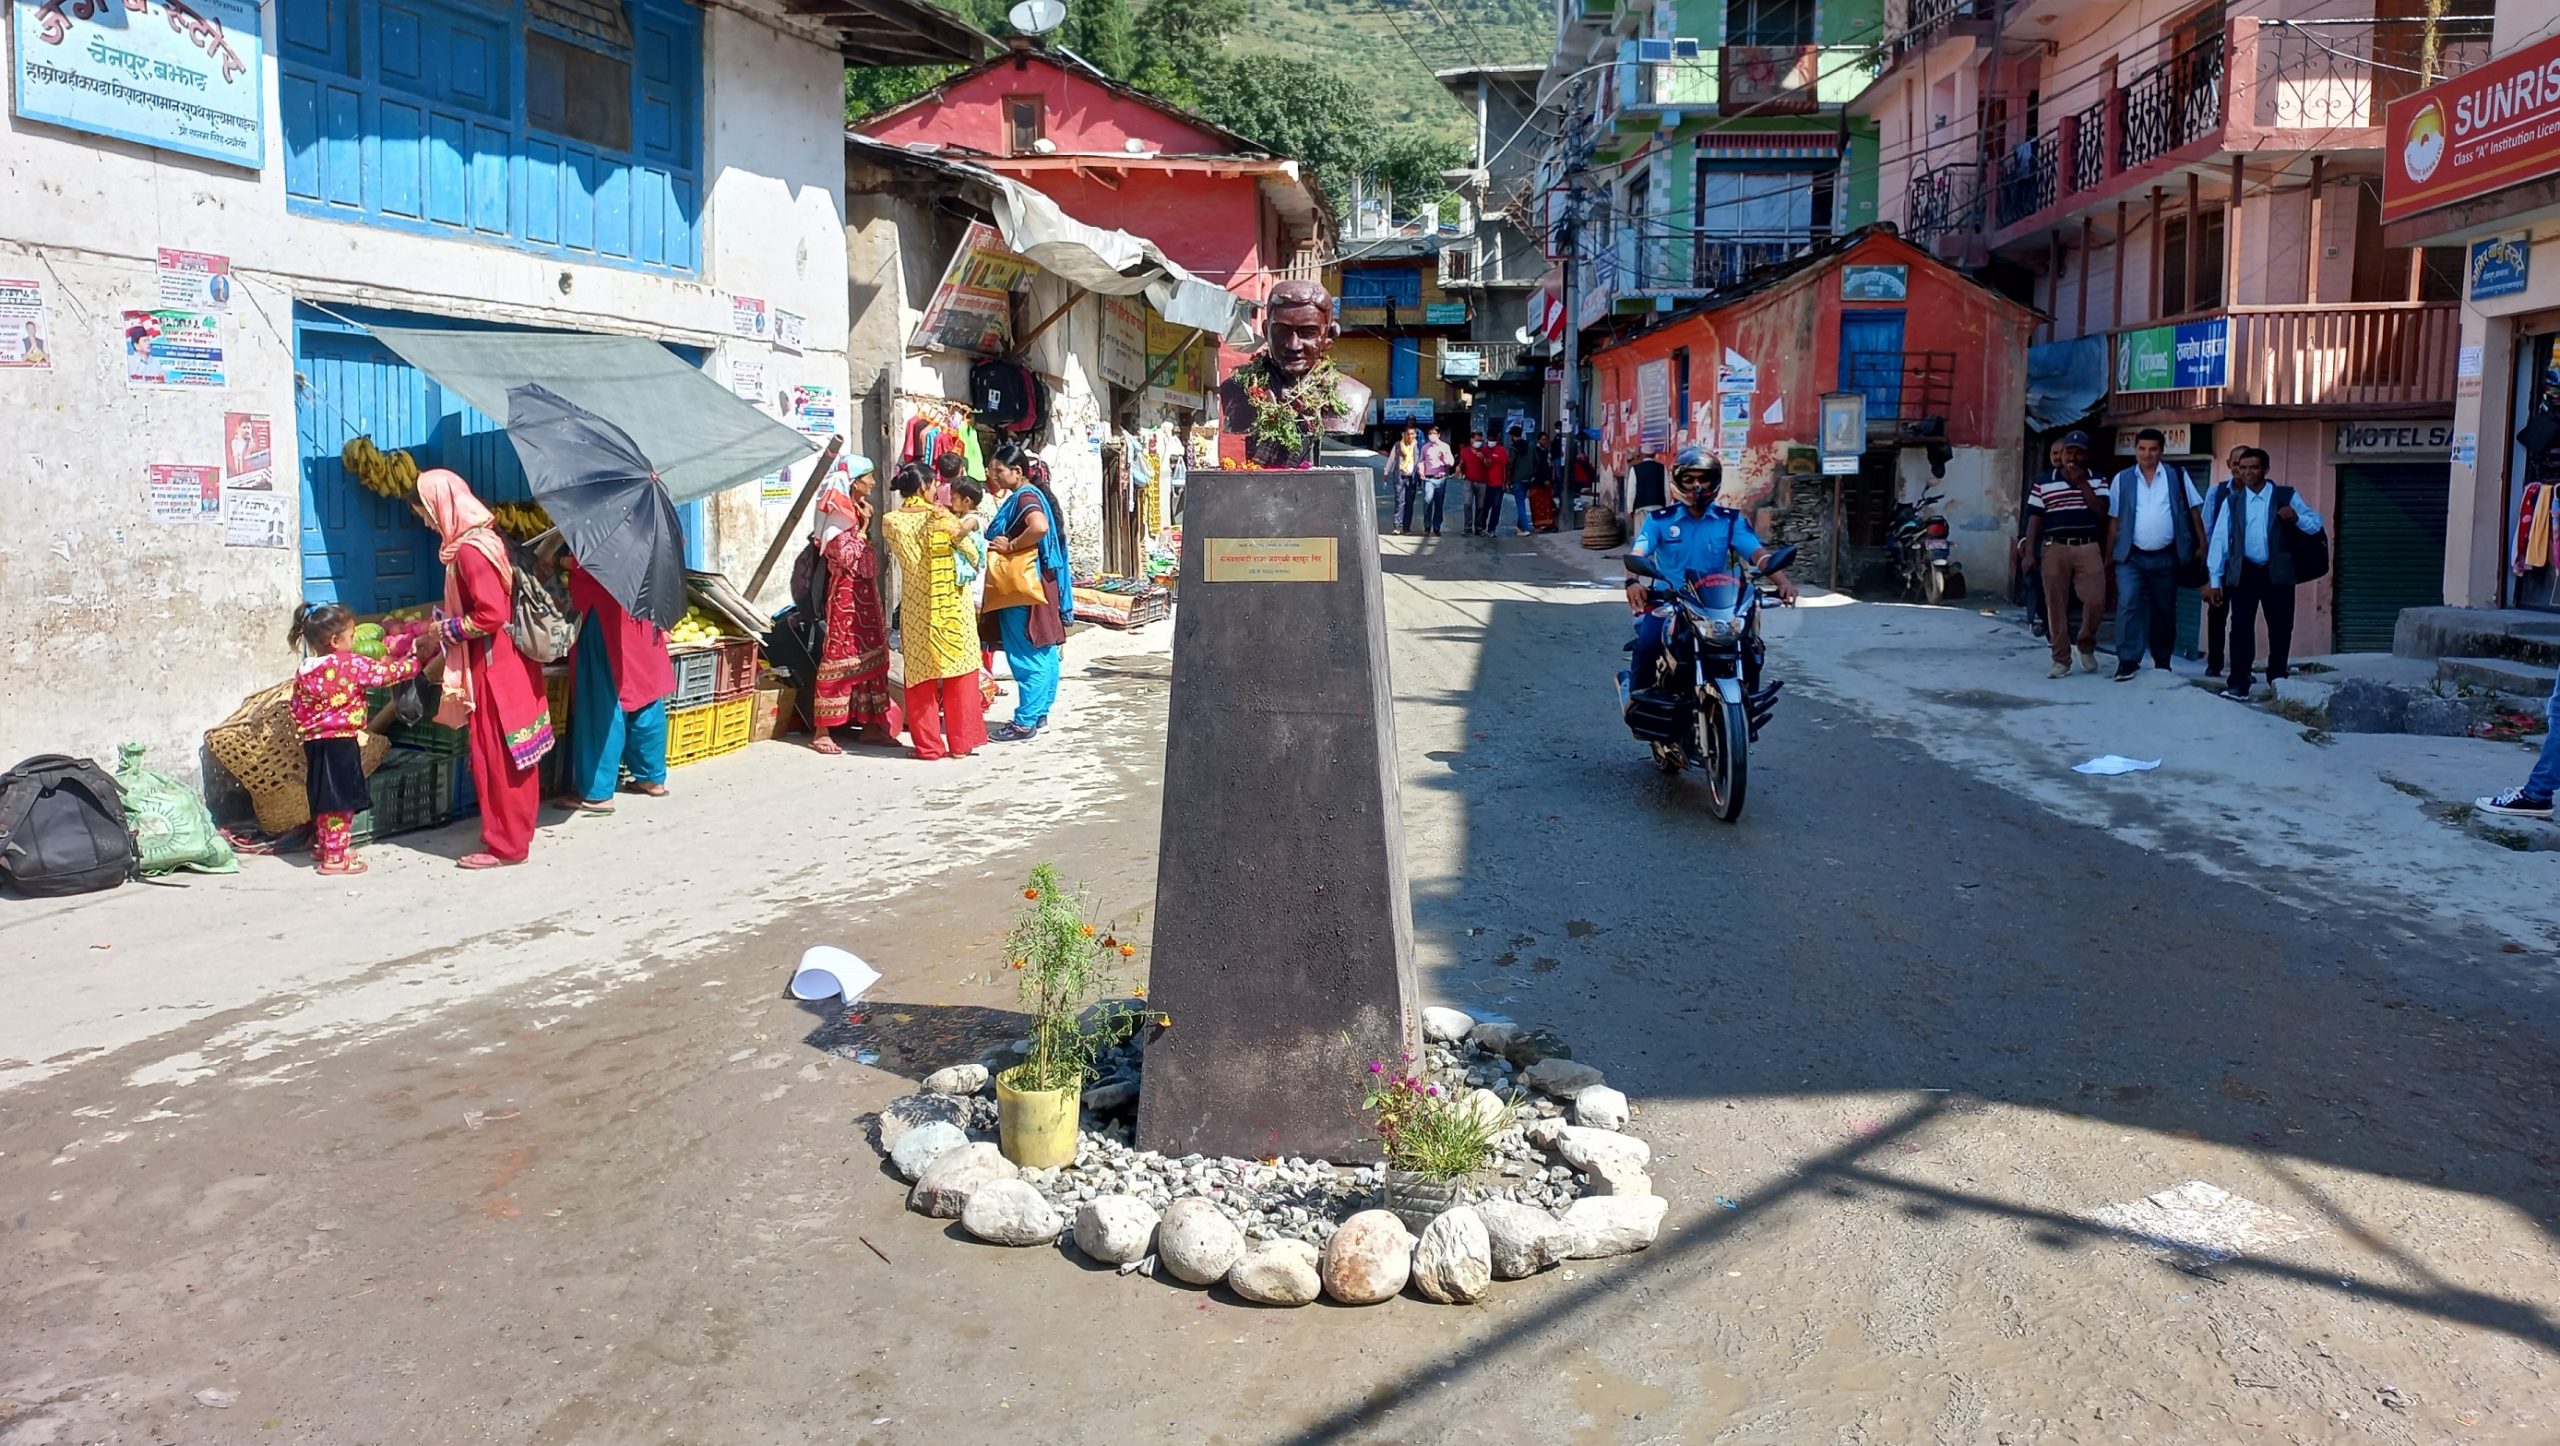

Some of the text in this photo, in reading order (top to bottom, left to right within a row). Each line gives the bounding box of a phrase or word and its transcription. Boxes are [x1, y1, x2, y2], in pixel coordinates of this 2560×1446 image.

[2453, 150, 2473, 167] Class
[2490, 130, 2535, 155] Institution
[2139, 352, 2168, 372] TUBORG
[2346, 427, 2423, 447] HOTEL
